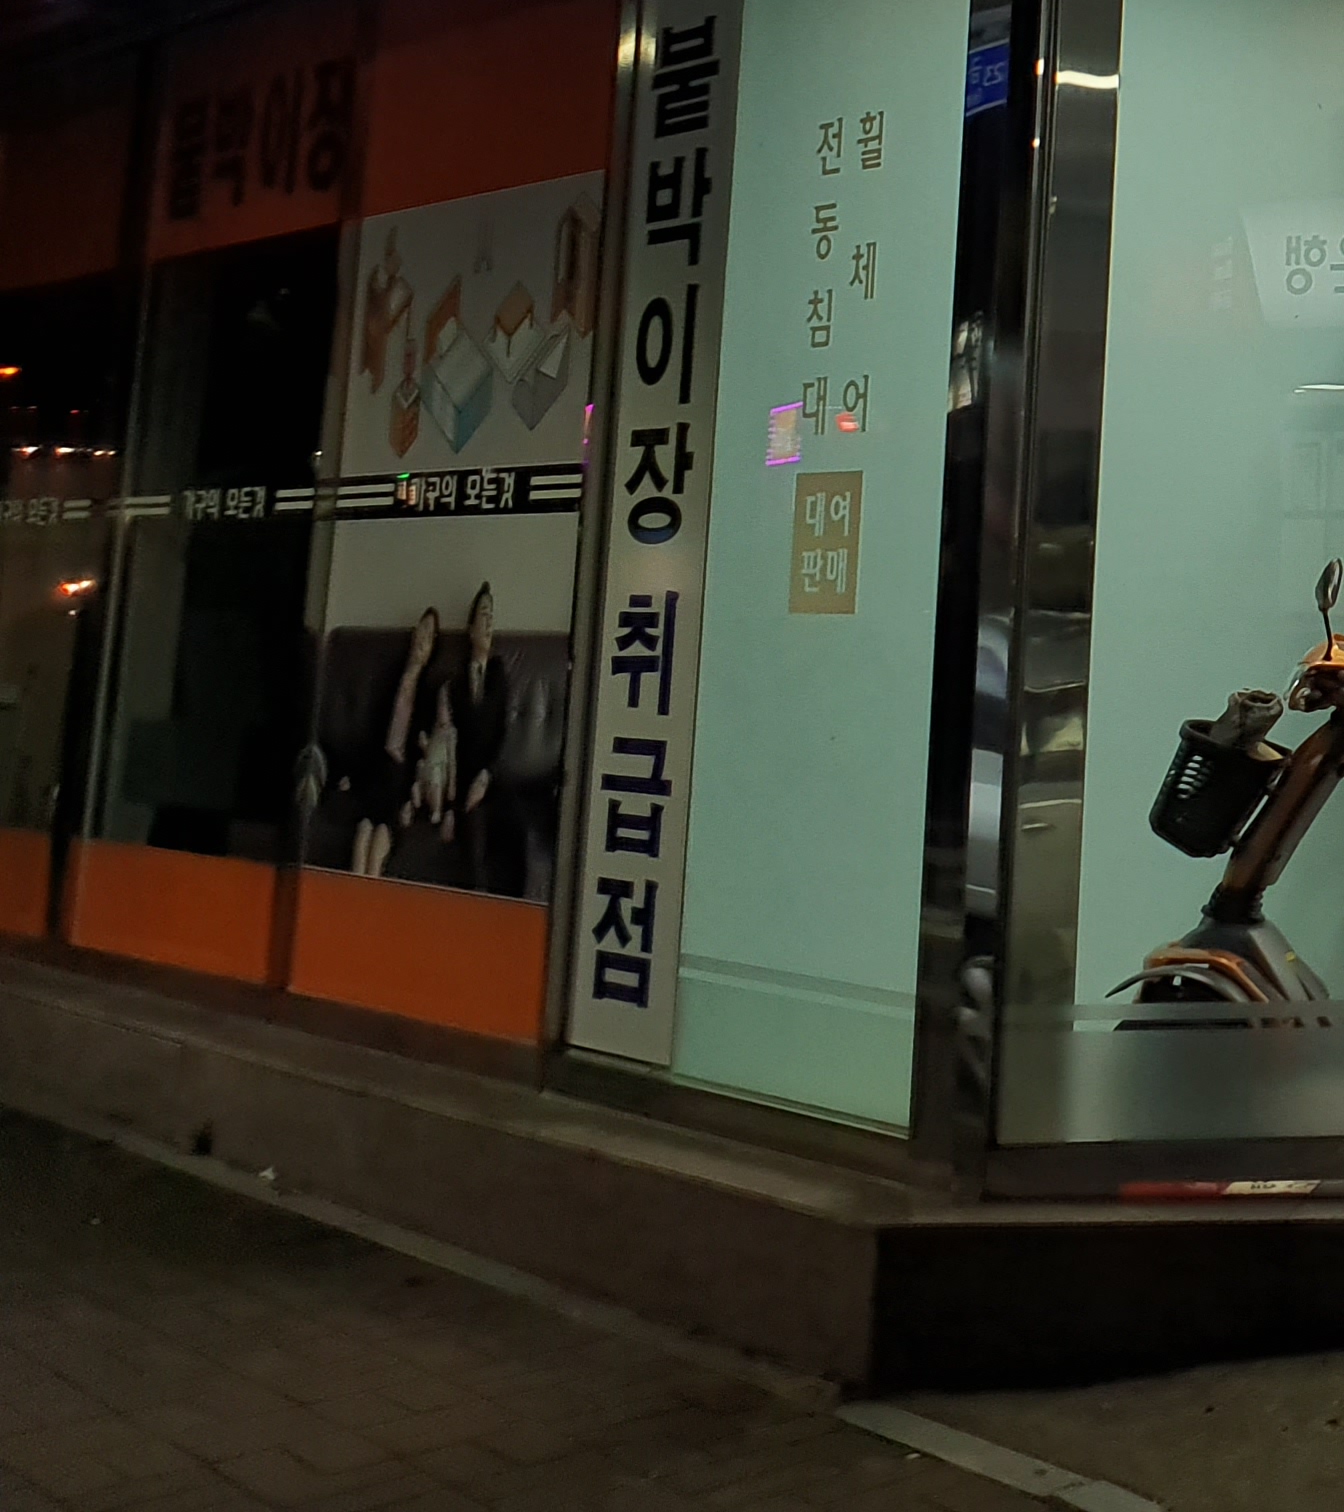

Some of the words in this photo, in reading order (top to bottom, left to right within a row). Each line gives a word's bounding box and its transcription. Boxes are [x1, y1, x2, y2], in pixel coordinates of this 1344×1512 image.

[803, 488, 853, 540] 대여
[799, 547, 850, 595] 판매
[591, 590, 680, 1009] 취급점
